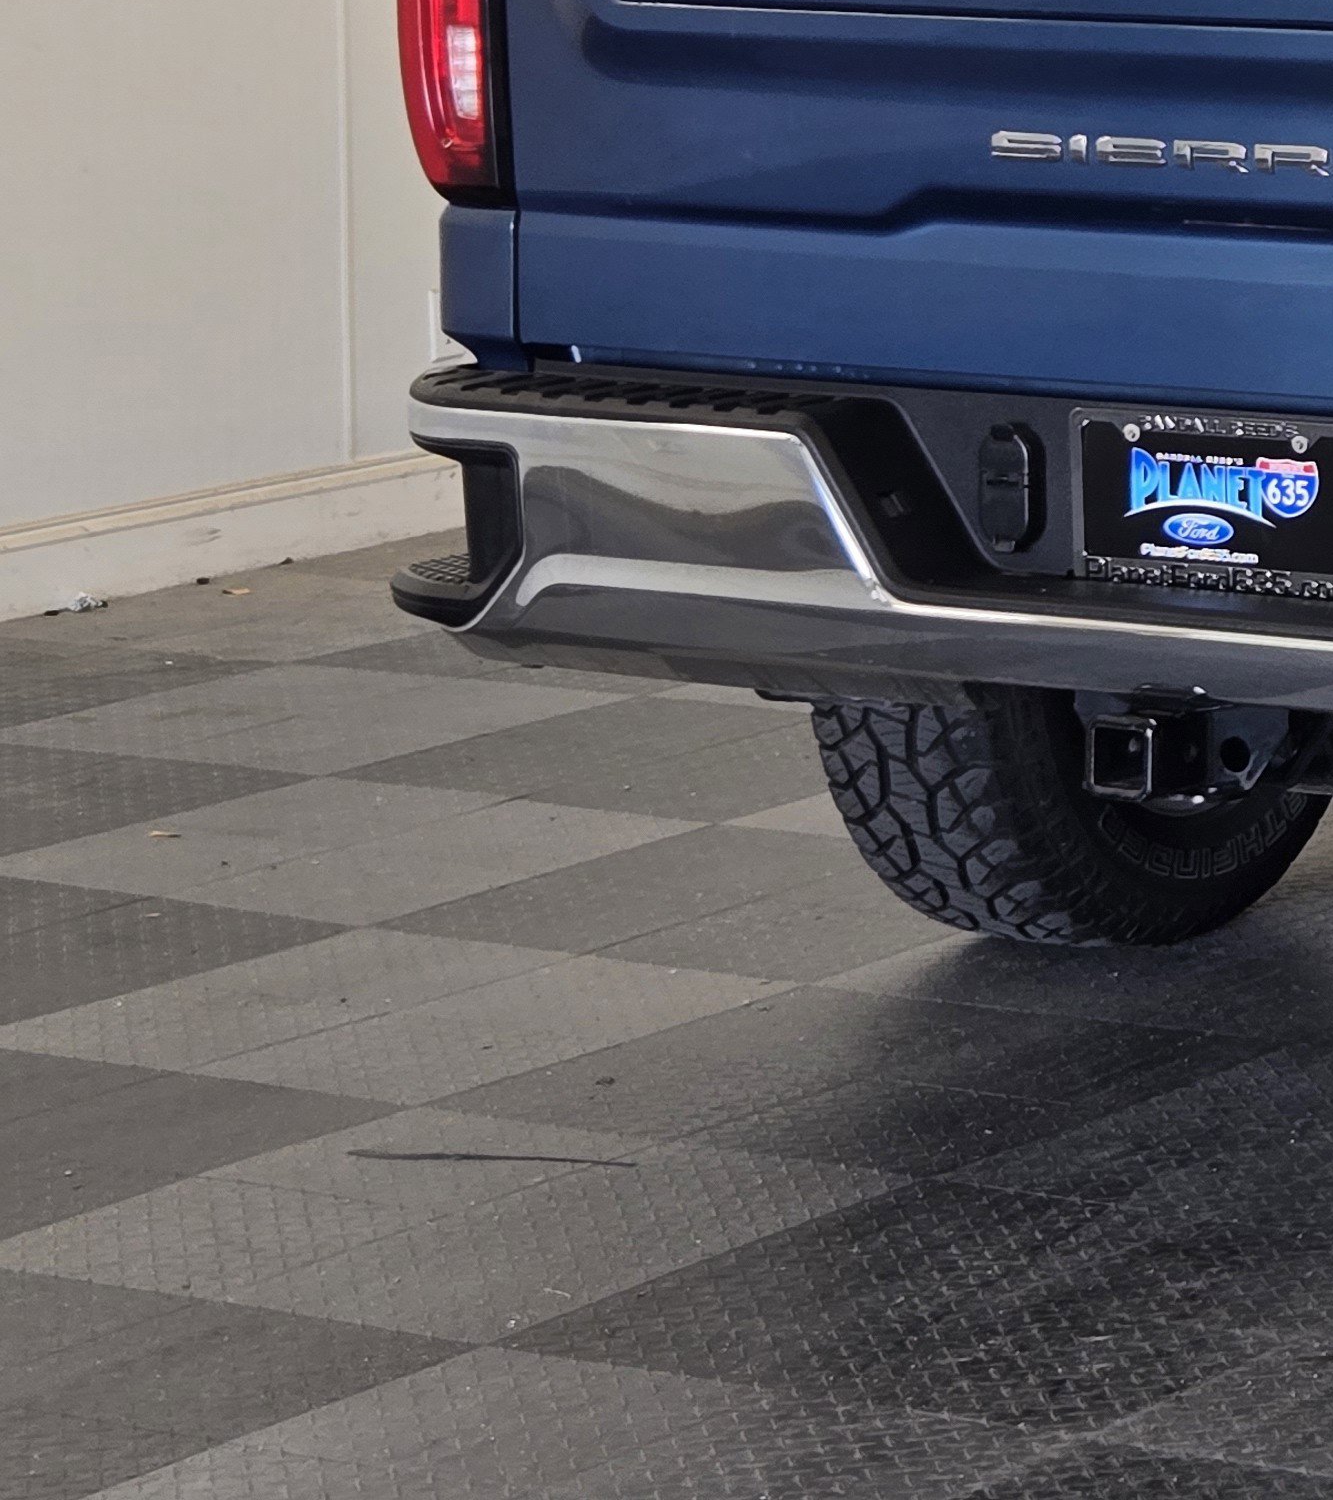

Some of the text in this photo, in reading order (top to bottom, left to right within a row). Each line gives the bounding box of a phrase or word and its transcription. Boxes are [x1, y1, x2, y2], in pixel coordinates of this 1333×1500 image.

[1131, 446, 1310, 519] PLANET 635
[1178, 518, 1220, 542] Ford
